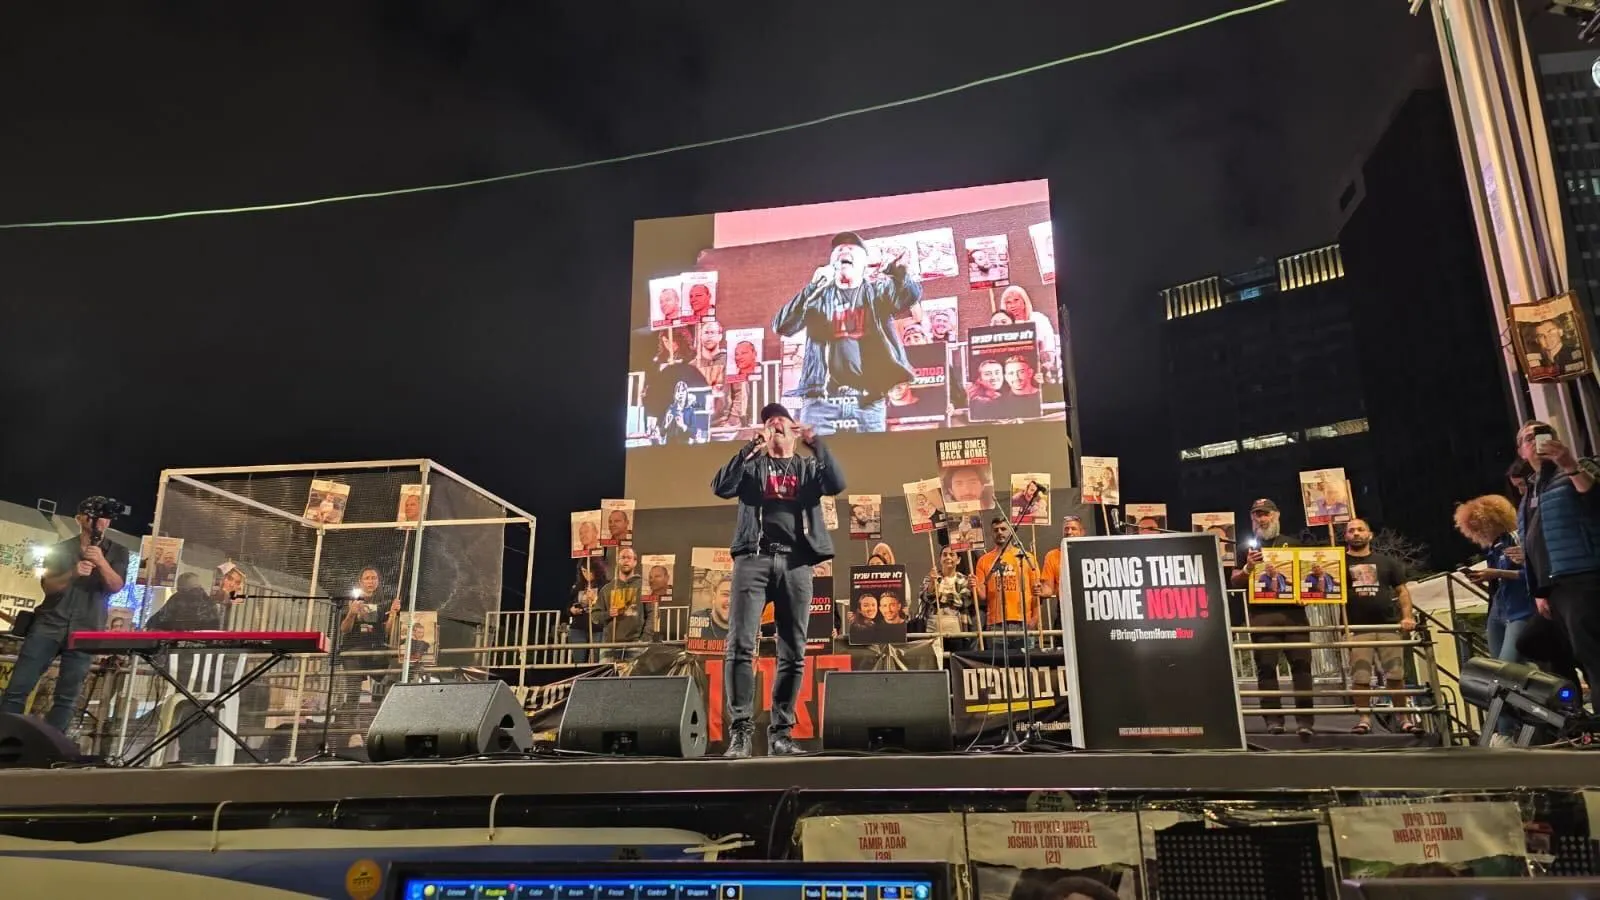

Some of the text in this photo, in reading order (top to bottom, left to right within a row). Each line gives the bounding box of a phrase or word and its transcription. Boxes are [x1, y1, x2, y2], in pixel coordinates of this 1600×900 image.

[940, 439, 986, 451] BRING OMER
[941, 449, 988, 461] BACK HOME
[1081, 555, 1206, 588] BRING THEM
[1084, 587, 1209, 621] HOME NOW!
[1110, 628, 1193, 642] #BringThemHomeNow
[1008, 835, 1097, 849] JOSHUA LOITU MOLLEL
[1393, 826, 1463, 844] INBAR HAYMAN
[859, 836, 907, 850] TAMIR ADAR
[1045, 850, 1061, 865] (21)
[1423, 843, 1440, 860] (27)
